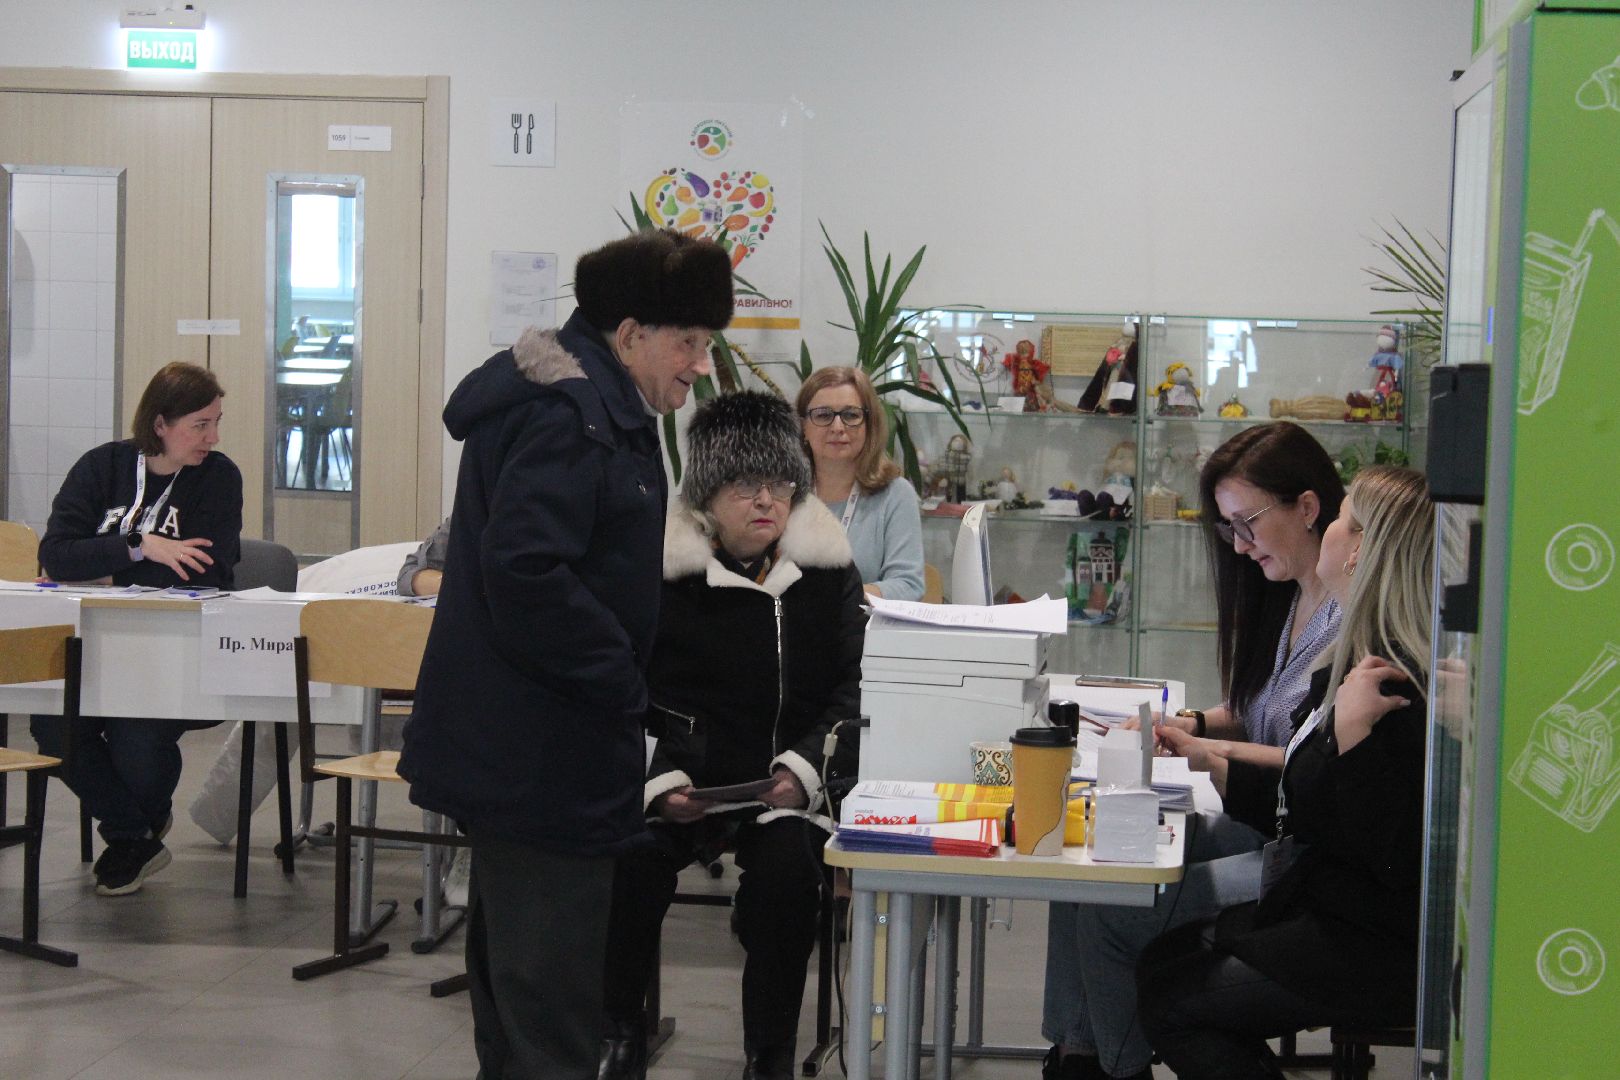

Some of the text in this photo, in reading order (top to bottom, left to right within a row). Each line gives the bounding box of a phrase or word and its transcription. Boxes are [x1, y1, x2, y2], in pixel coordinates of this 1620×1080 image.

[129, 40, 195, 64] ВЫХОД
[219, 636, 293, 654] Пр. Мира
